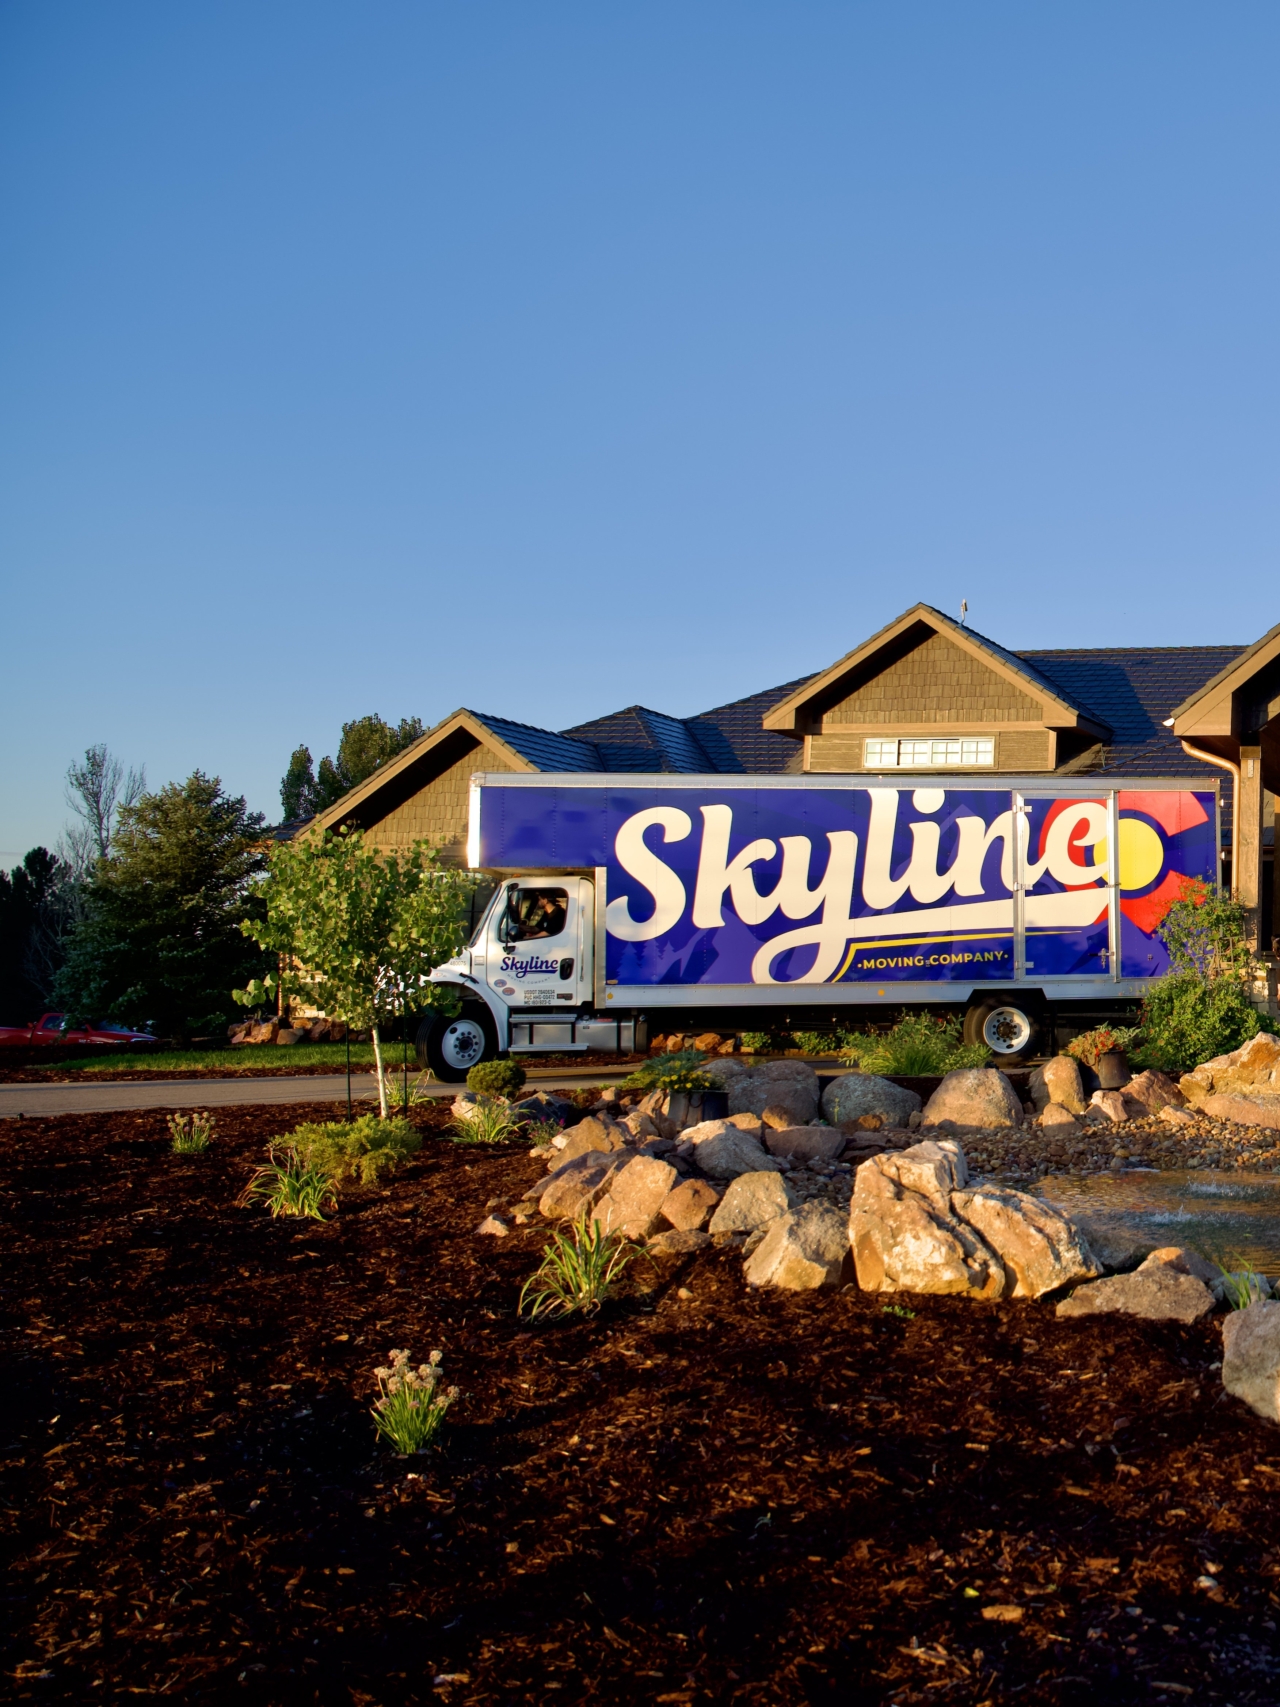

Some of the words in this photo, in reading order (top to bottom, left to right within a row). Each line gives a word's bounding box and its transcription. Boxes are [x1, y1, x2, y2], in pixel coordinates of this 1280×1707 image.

[606, 789, 1110, 984] Skyline
[500, 956, 559, 979] Skyline
[863, 956, 924, 969] MOVING
[929, 951, 1004, 965] COMPANY
[507, 973, 525, 984] MOVING
[527, 976, 551, 984] COMPANY
